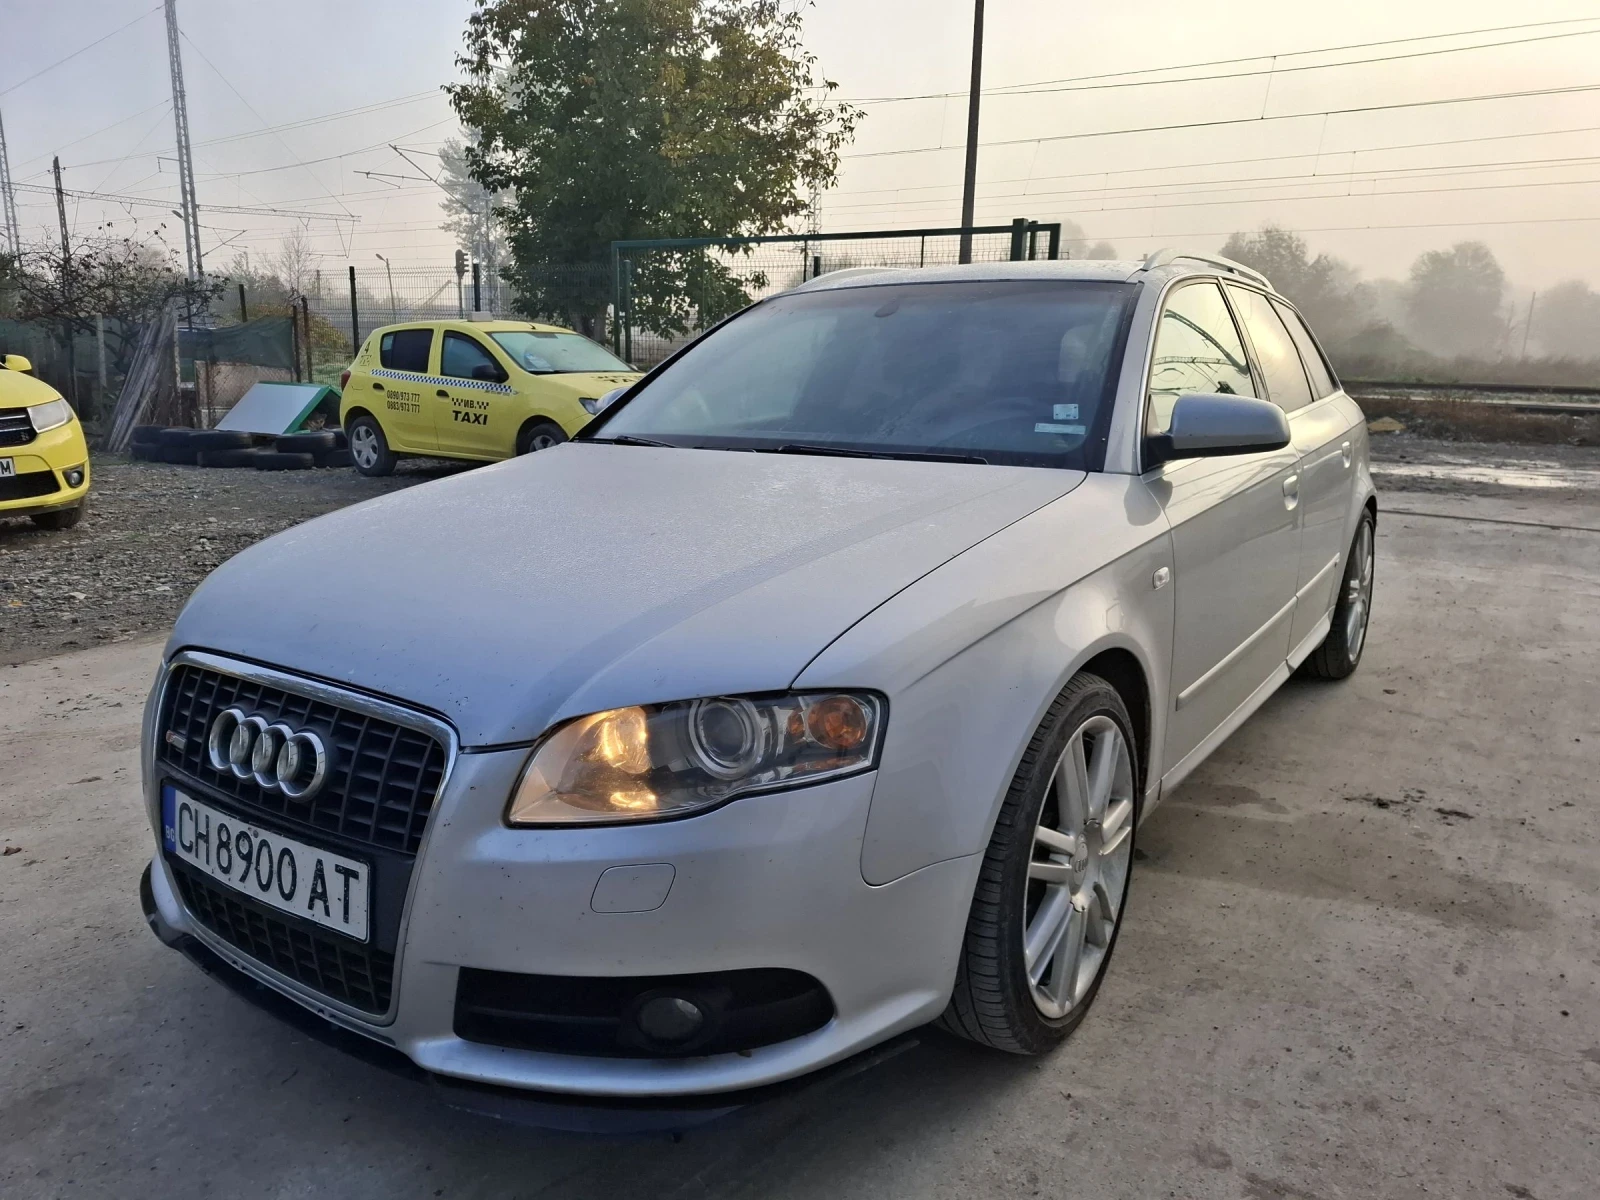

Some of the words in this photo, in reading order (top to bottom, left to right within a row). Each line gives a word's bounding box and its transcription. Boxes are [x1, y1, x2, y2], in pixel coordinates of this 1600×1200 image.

[386, 390, 410, 402] 0890/973
[411, 393, 421, 403] 777
[411, 403, 421, 414] 777
[452, 410, 489, 426] TAXI
[165, 824, 176, 843] BG
[307, 858, 360, 925] AT
